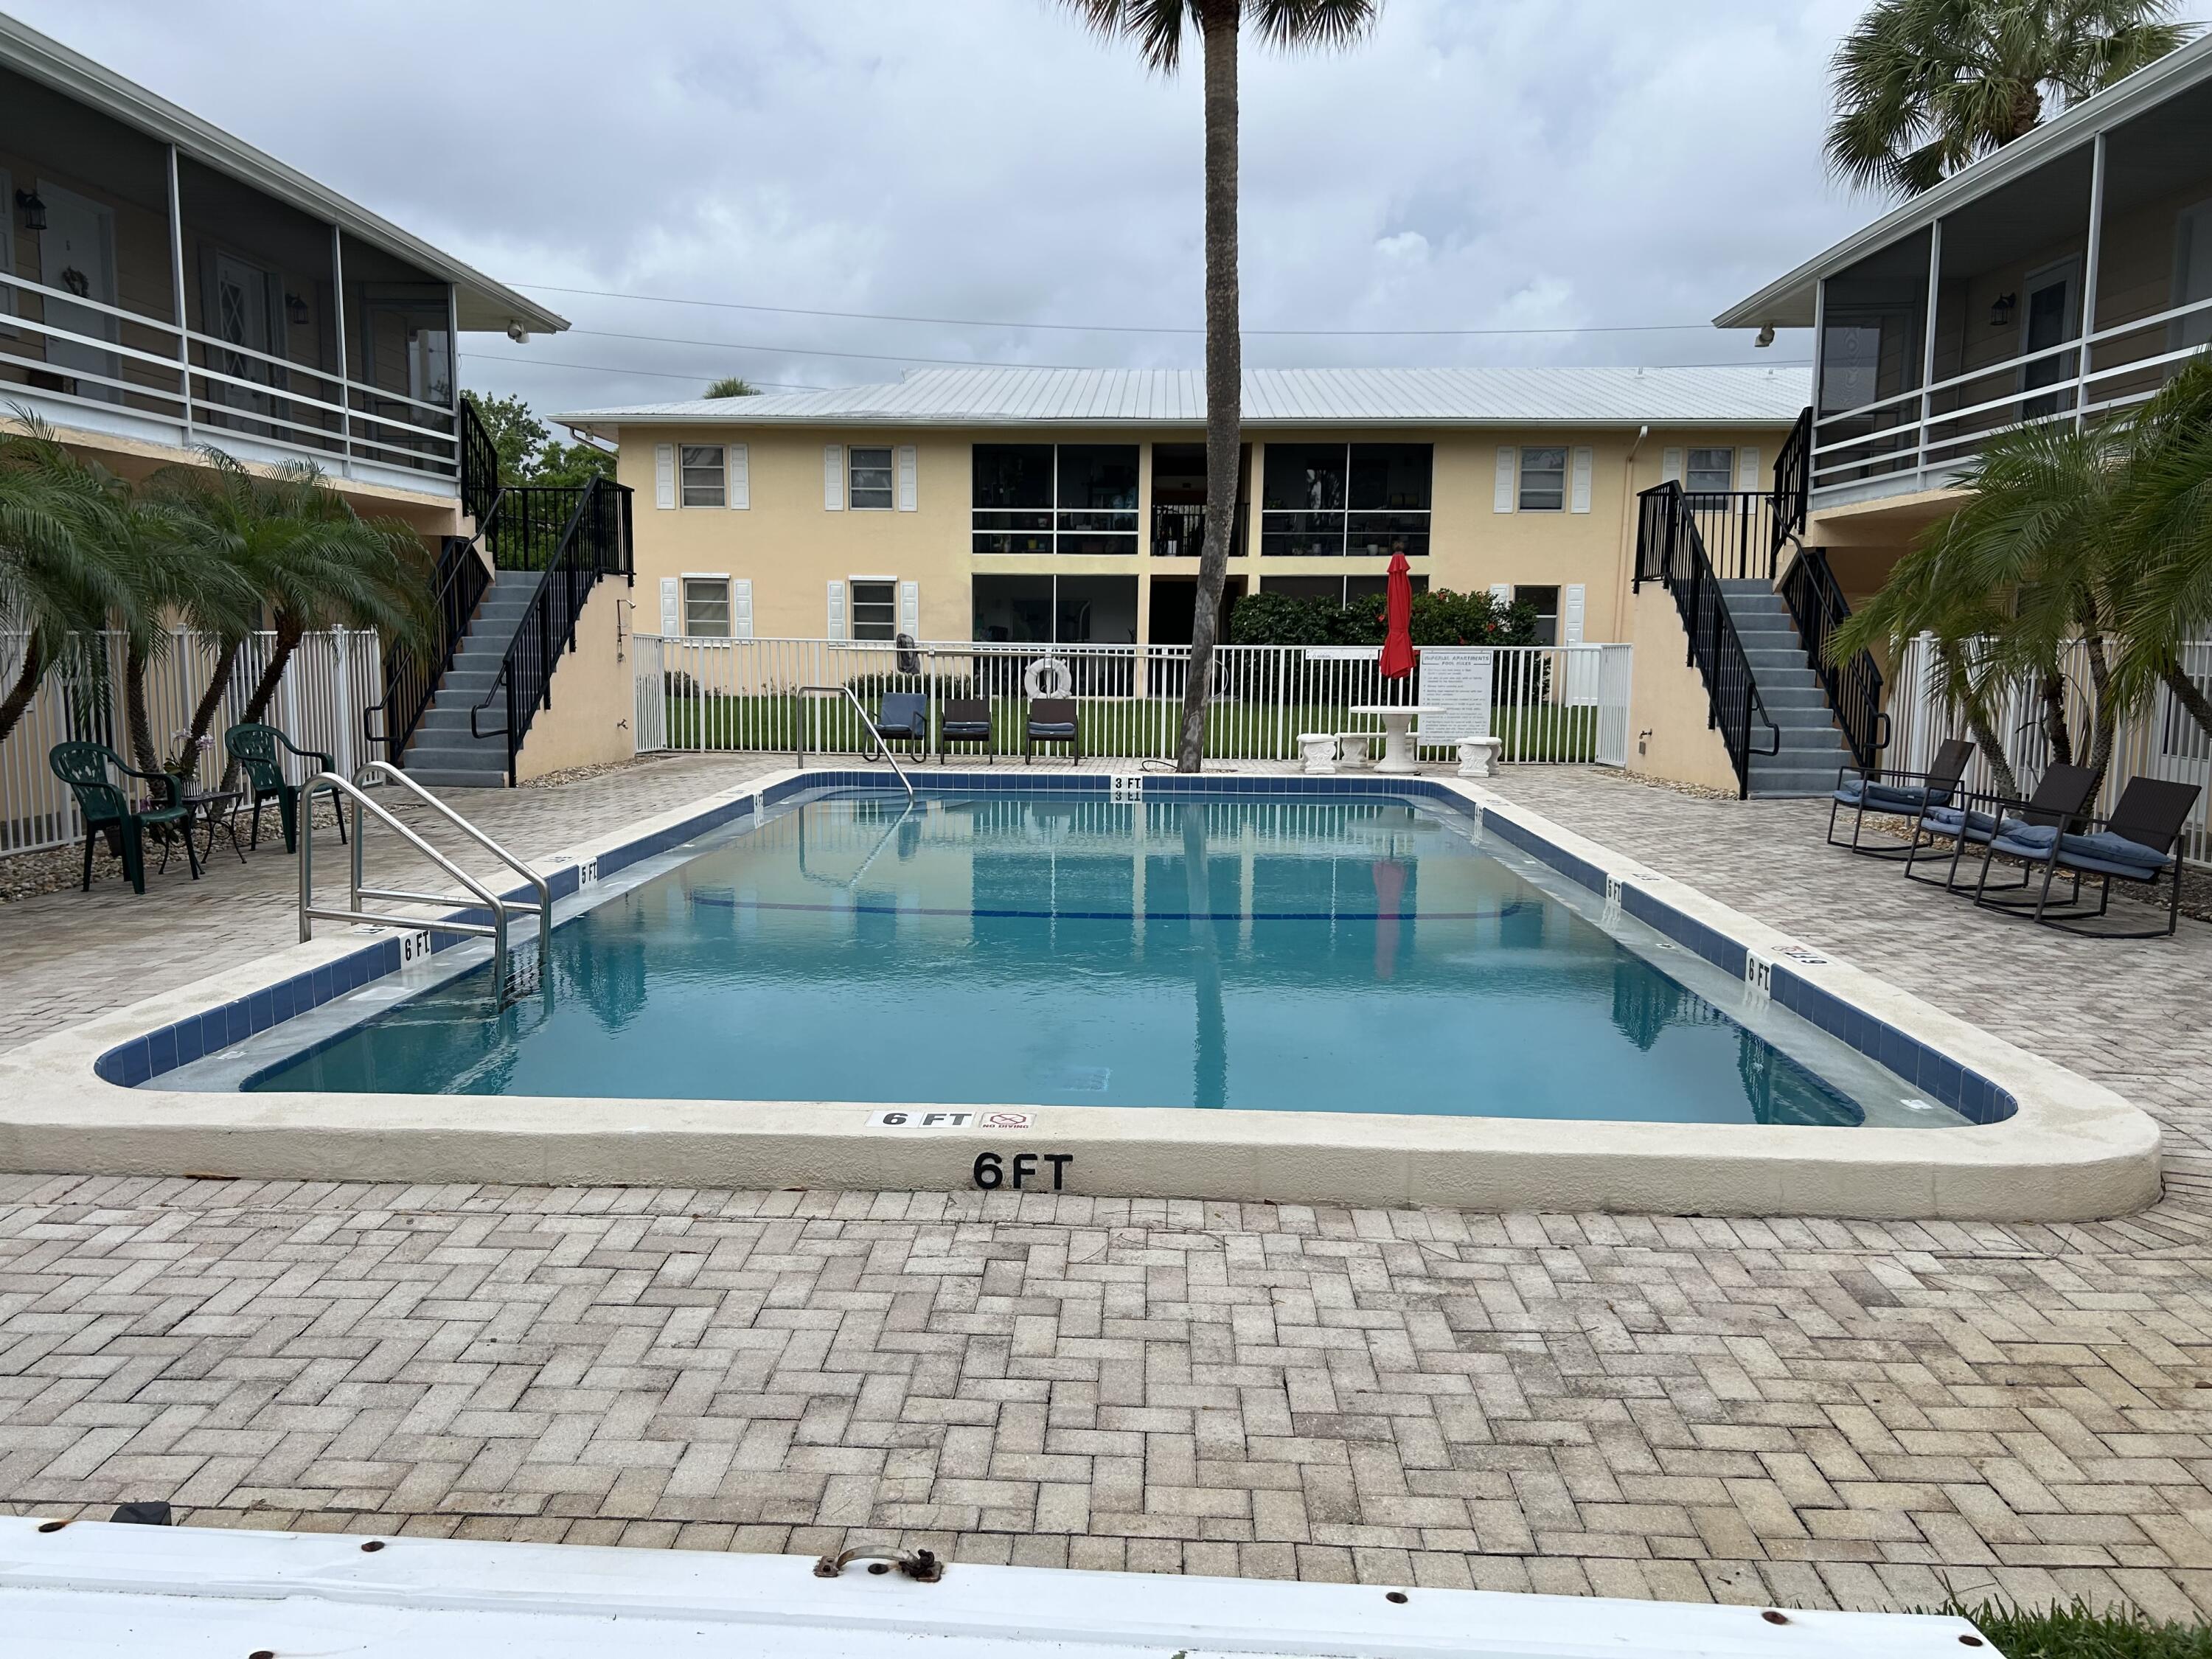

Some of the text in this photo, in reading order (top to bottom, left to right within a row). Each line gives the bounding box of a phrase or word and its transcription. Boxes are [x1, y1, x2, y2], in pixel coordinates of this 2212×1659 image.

[1116, 778, 1121, 789] 3
[582, 866, 586, 884] 5
[1608, 879, 1612, 897] 5
[405, 938, 411, 961] 6
[1749, 958, 1754, 981] 6
[883, 1113, 972, 1126] 6 FT
